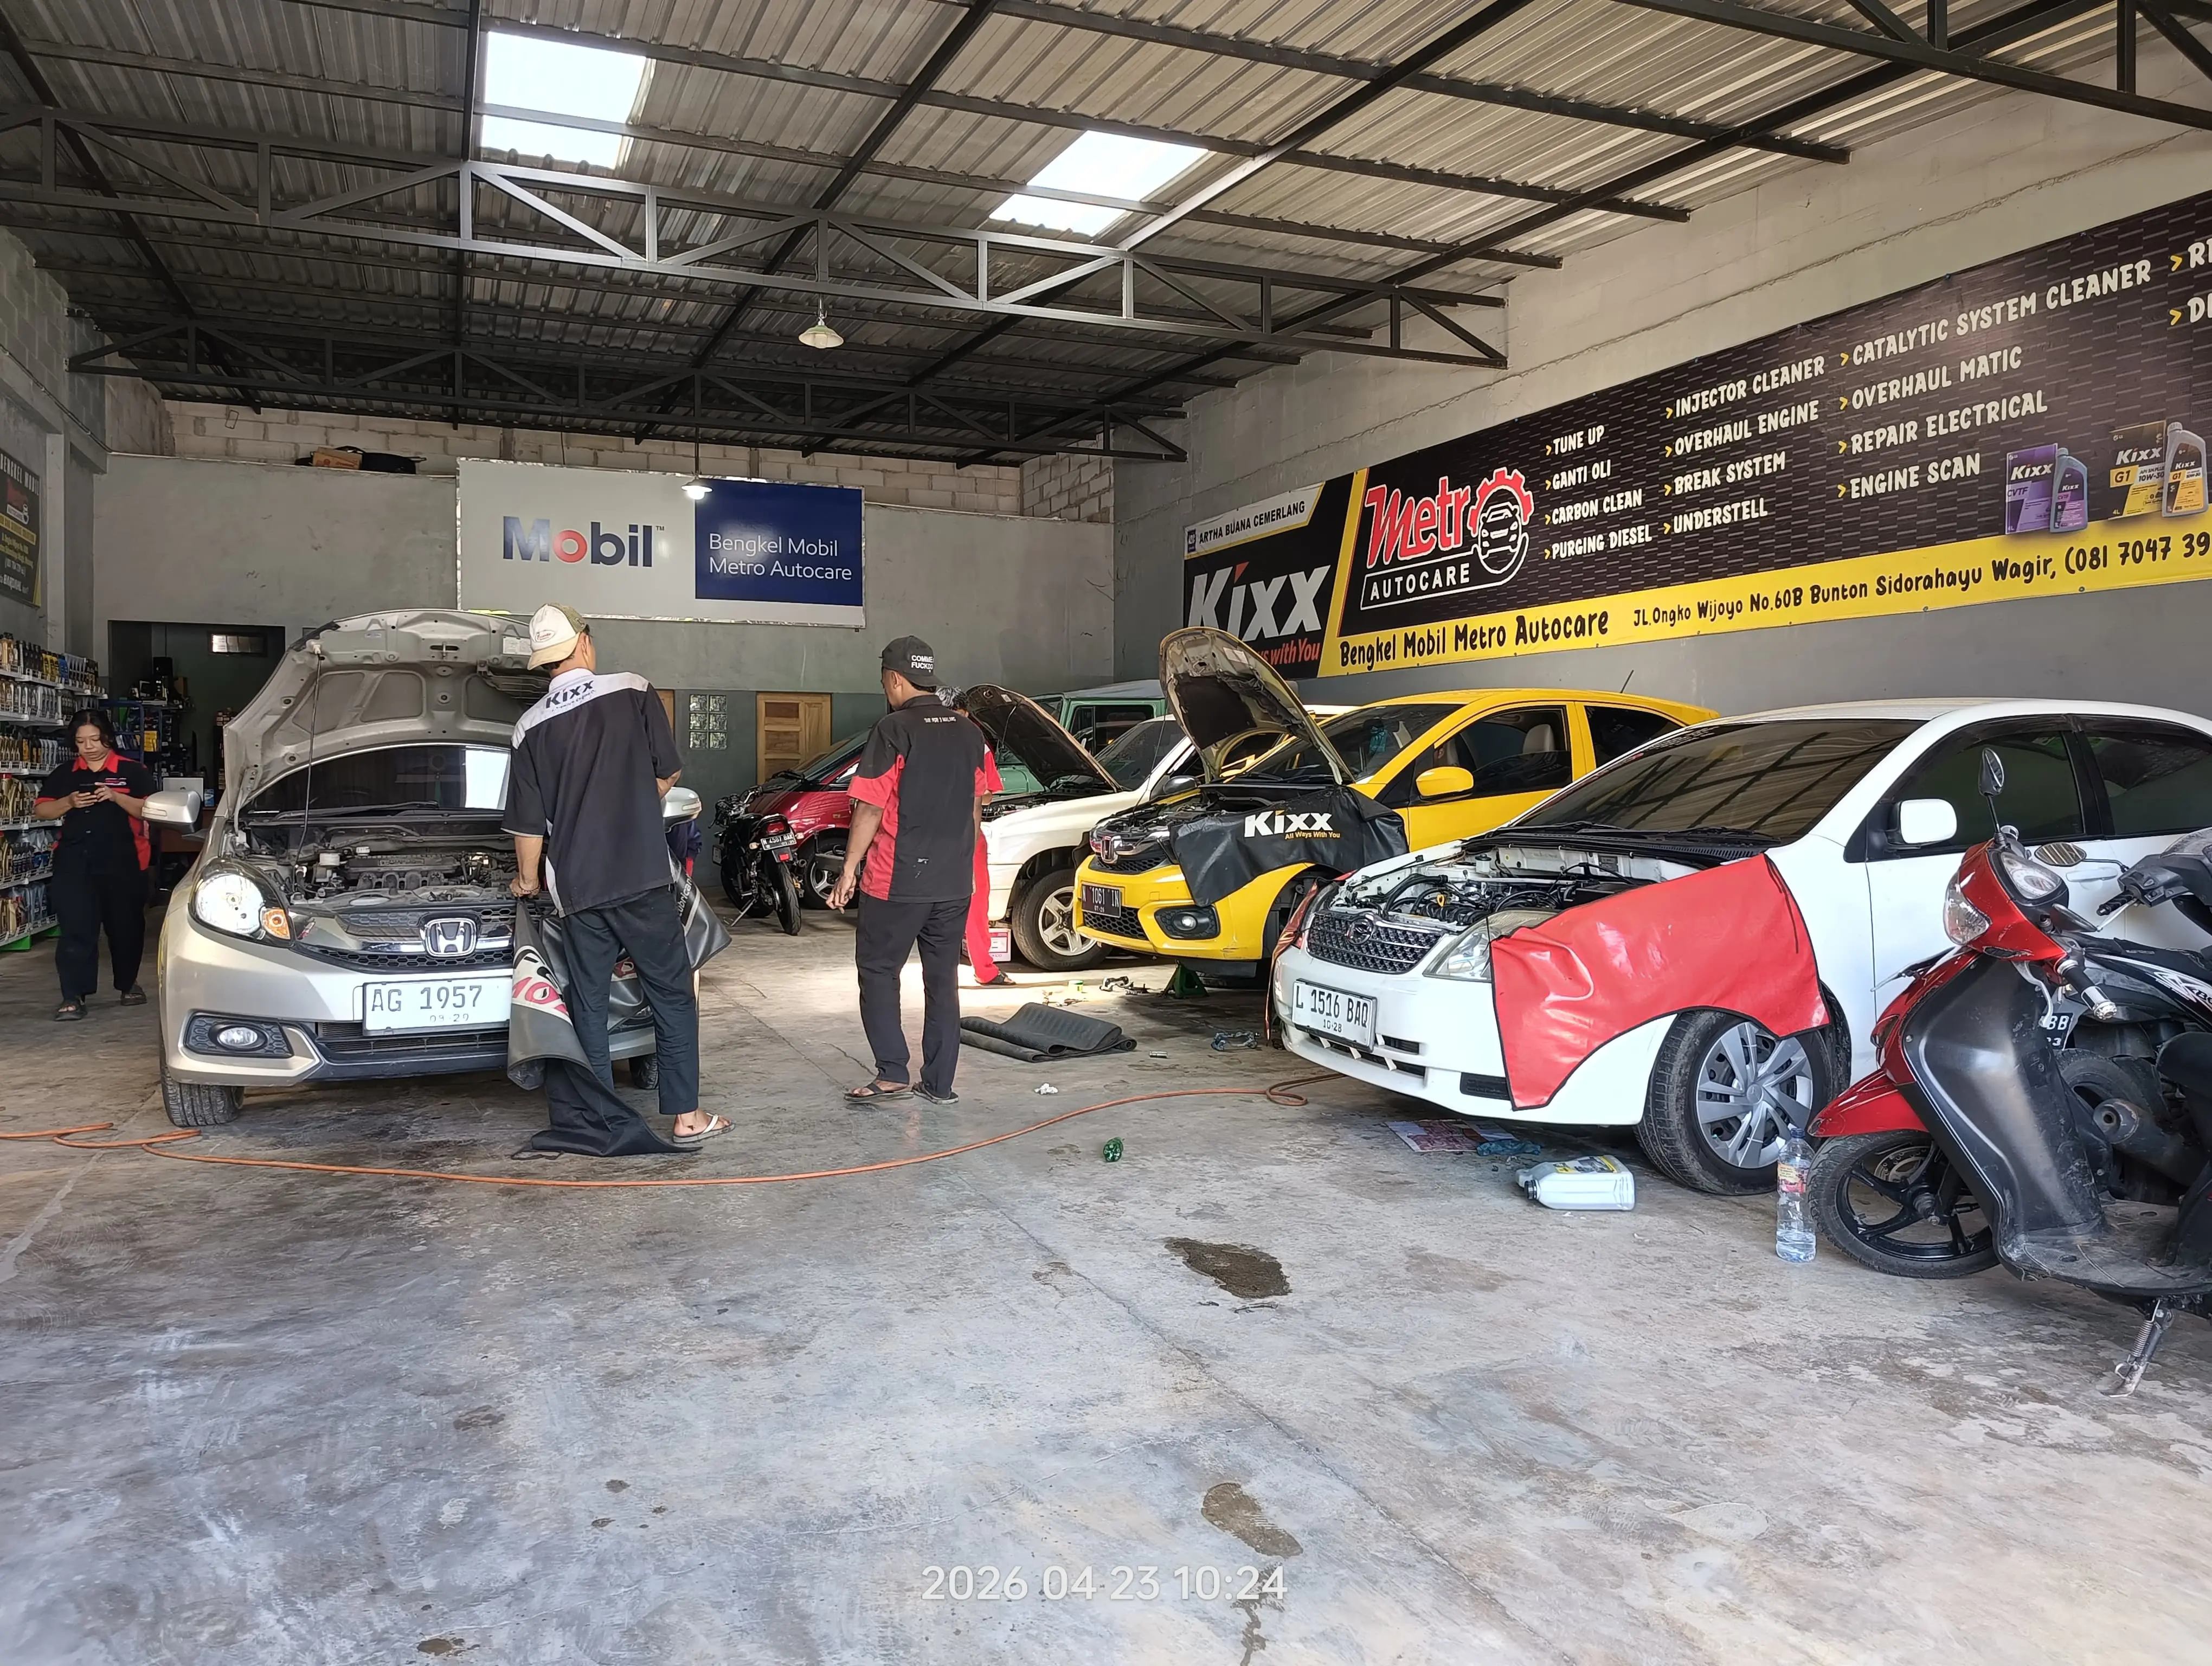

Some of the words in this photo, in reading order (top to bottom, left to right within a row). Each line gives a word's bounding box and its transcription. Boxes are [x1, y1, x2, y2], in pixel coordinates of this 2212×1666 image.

[1853, 319, 1949, 366] CATALYTIC
[1956, 292, 2037, 336] SYSTEM
[2046, 259, 2151, 310] CLEANER
[1675, 380, 1747, 417] INJECTOR
[1753, 356, 1824, 394] CLEANER
[1851, 366, 1952, 410] OVERHAUL
[1960, 346, 2022, 383] MATIC
[1675, 419, 1752, 456] OVERHAUL
[1758, 400, 1819, 434] ENGINE
[1851, 421, 1918, 454] REPAIR
[1926, 390, 2048, 438] ELECTRICAL
[1553, 431, 1584, 455] TUNE
[1588, 425, 1605, 445] UP
[2115, 448, 2162, 465] Kixx
[1552, 467, 1587, 490] GANTI
[1592, 459, 1611, 480] OLI
[1674, 468, 1721, 495] BREAK
[1726, 451, 1785, 483] SYSTEM
[1850, 465, 1919, 499] ENGINE
[1927, 453, 1980, 484] SCAN
[2010, 463, 2053, 480] Kixx
[2115, 470, 2131, 483] G1
[2172, 472, 2182, 480] G1
[2175, 460, 2195, 470] Kixx
[1552, 498, 1598, 525] CARBON
[1603, 489, 1642, 513] CLEAN
[2008, 486, 2028, 497] CVTF
[1199, 527, 1223, 544] ARTHA
[1225, 518, 1251, 536] BUANA
[1253, 501, 1305, 527] CEMERLANG
[1674, 497, 1768, 534] UNDERSTELL
[503, 516, 652, 567] Mobil
[709, 534, 782, 556] Bengkel
[788, 537, 838, 557] Mobil
[1552, 534, 1604, 560] PURGING
[1609, 525, 1652, 551] DIESEL
[709, 558, 765, 576] Metro
[770, 561, 852, 581] Autocare
[1370, 562, 1470, 600] AUTOCARE
[1697, 600, 1743, 622] Wijoyo
[1750, 587, 1803, 612] No.60B
[1810, 582, 1868, 604] Bunton
[1876, 567, 1982, 596] Sidorahayu
[1992, 555, 2056, 584] Wagir,
[2065, 545, 2107, 574] (081
[2119, 536, 2171, 566] 7047
[2182, 532, 2210, 559] 39
[1188, 562, 1330, 642] Kixx
[1270, 639, 1296, 665] with
[1298, 637, 1321, 664] You
[1340, 633, 1396, 671] Bengkel
[1404, 627, 1445, 658] Mobil
[1455, 624, 1506, 652] Metro
[1515, 610, 1609, 645] Autocare
[546, 680, 594, 709] Kixx
[1244, 810, 1333, 837] Kixx
[1092, 887, 1105, 905] 1061
[1112, 890, 1119, 908] IN
[371, 989, 402, 1011] AG
[420, 985, 482, 1009] 1957
[1295, 985, 1303, 1009] L
[1311, 989, 1340, 1018] 1516
[1347, 997, 1368, 1028] BAQ
